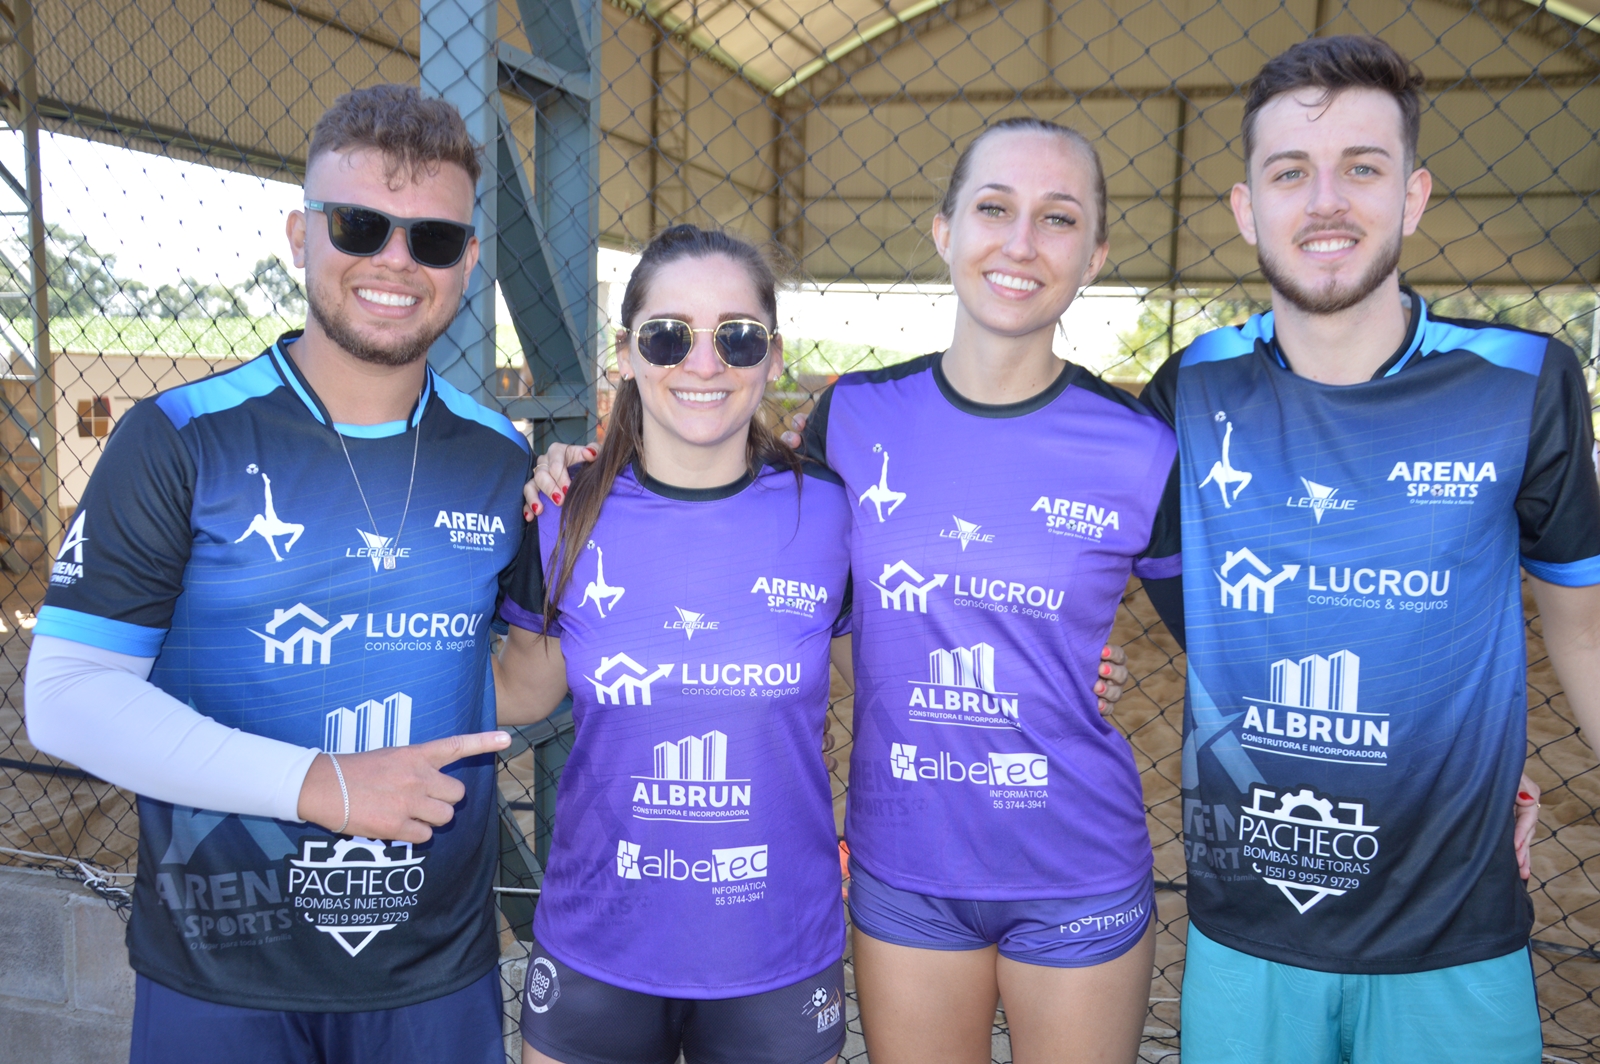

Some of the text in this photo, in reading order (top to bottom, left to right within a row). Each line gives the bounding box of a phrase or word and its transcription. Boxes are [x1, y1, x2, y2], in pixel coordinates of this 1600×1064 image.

[1387, 461, 1497, 482] ARENA
[1031, 496, 1119, 531] ARENA
[1286, 496, 1358, 511] LEAGUE
[434, 510, 505, 534] ARENA
[939, 528, 996, 543] LEAGUE
[345, 547, 411, 558] LEAGUE
[750, 576, 828, 604] ARENA
[1308, 565, 1450, 597] LUCROU
[954, 574, 1065, 611] LUCROU
[1307, 593, 1448, 614] consórcios & seguros
[953, 597, 1060, 622] consórcios & seguros
[366, 612, 484, 638] LUCROU
[663, 620, 720, 631] LEAGUE
[364, 639, 432, 651] consórcios
[434, 640, 443, 651] &
[681, 662, 801, 686] LUCROU
[681, 686, 800, 698] consórcios & seguros
[908, 686, 1019, 719] ALBRUN
[908, 709, 957, 721] CONSTRUTORA
[1242, 705, 1390, 747] ALBRUN
[1241, 732, 1301, 751] CONSTRUTORA
[1309, 745, 1388, 759] INCORPORADORA
[919, 751, 1048, 786] albetec
[632, 782, 751, 808] ALBRUN
[989, 788, 1048, 799] INFORMÁTICA
[632, 805, 682, 816] CONSTRUTORA
[688, 809, 749, 818] INCORPORADORA
[993, 800, 1047, 810] 55 3744-3941
[1239, 814, 1379, 861] PACHECO
[642, 844, 768, 883] albetec
[1243, 845, 1371, 875] BOMBAS INJETORAS
[288, 866, 425, 896] PACHECO
[711, 881, 767, 895] INFORMÁTICA
[1288, 869, 1296, 879] 9
[1298, 871, 1328, 884] 9957
[1330, 876, 1360, 889] 9729
[294, 894, 418, 910] BOMBAS INJETORAS
[715, 891, 765, 906] 55 3744-3941
[341, 913, 349, 925] 9
[351, 912, 379, 924] 9957
[382, 911, 409, 923] 9729
